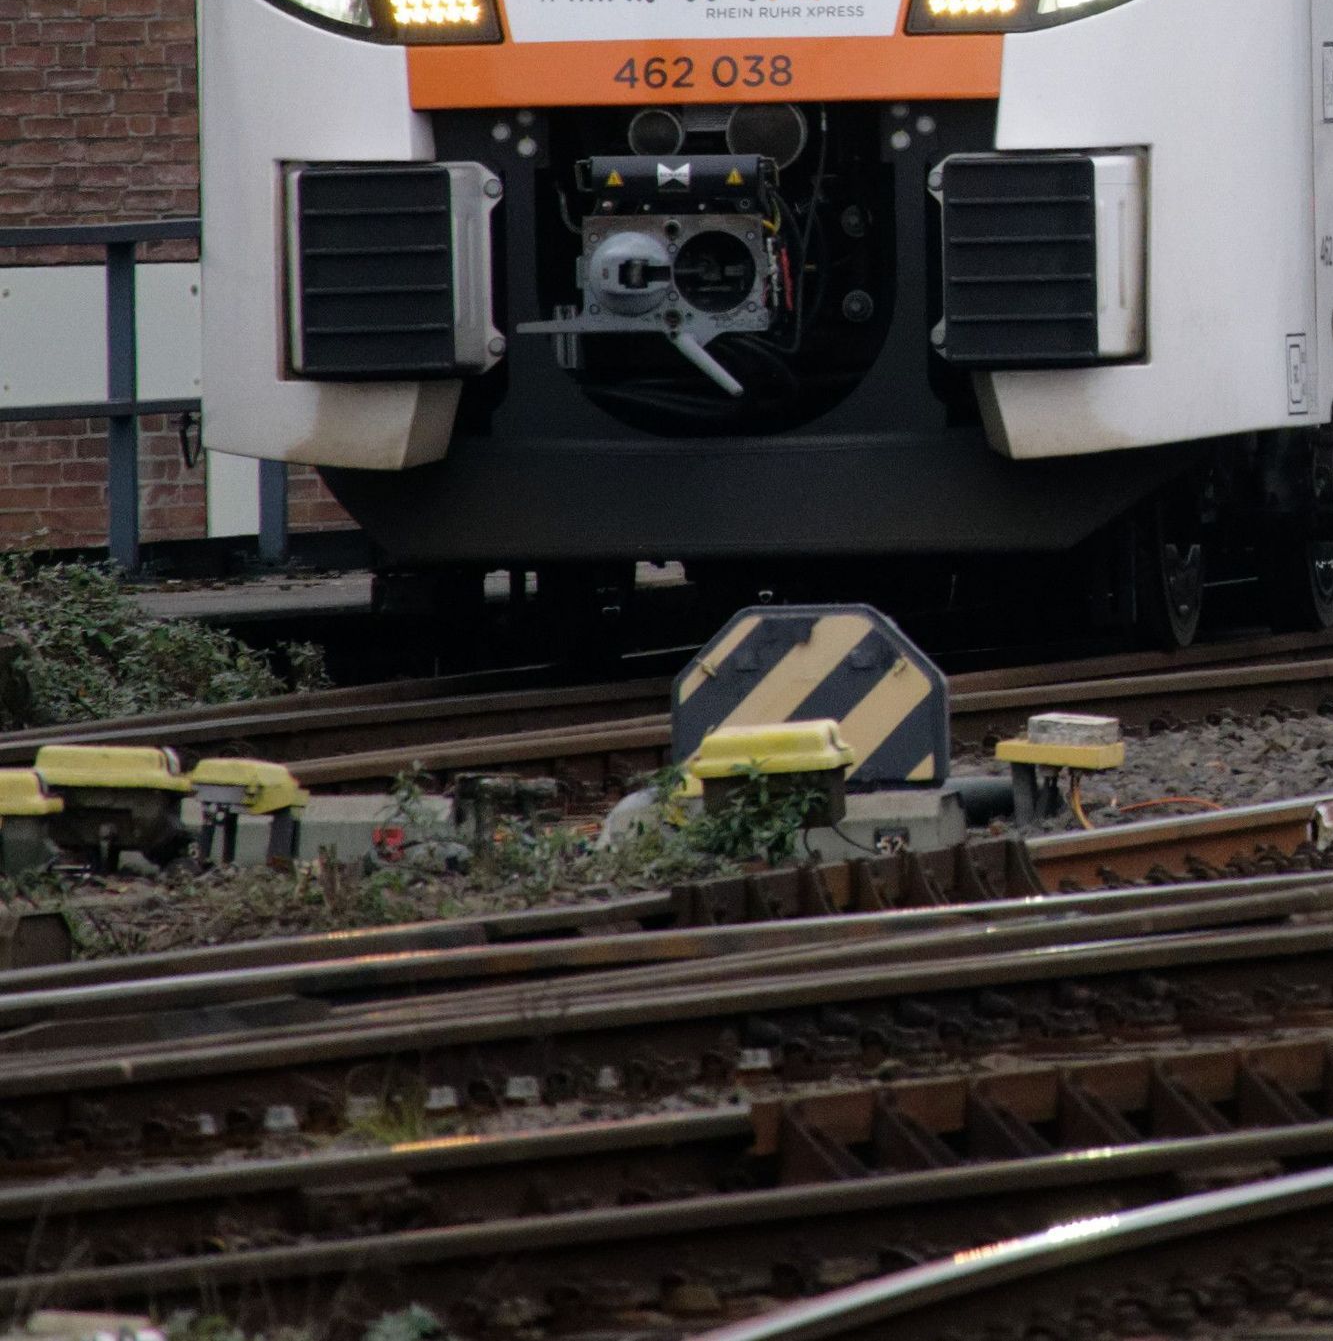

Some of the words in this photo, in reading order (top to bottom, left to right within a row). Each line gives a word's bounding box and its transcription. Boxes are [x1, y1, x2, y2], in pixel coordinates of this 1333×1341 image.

[705, 4, 755, 20] RHEIN
[758, 4, 803, 20] RUHR
[806, 3, 866, 18] XPRESS
[613, 55, 695, 89] 462
[711, 54, 794, 88] 038
